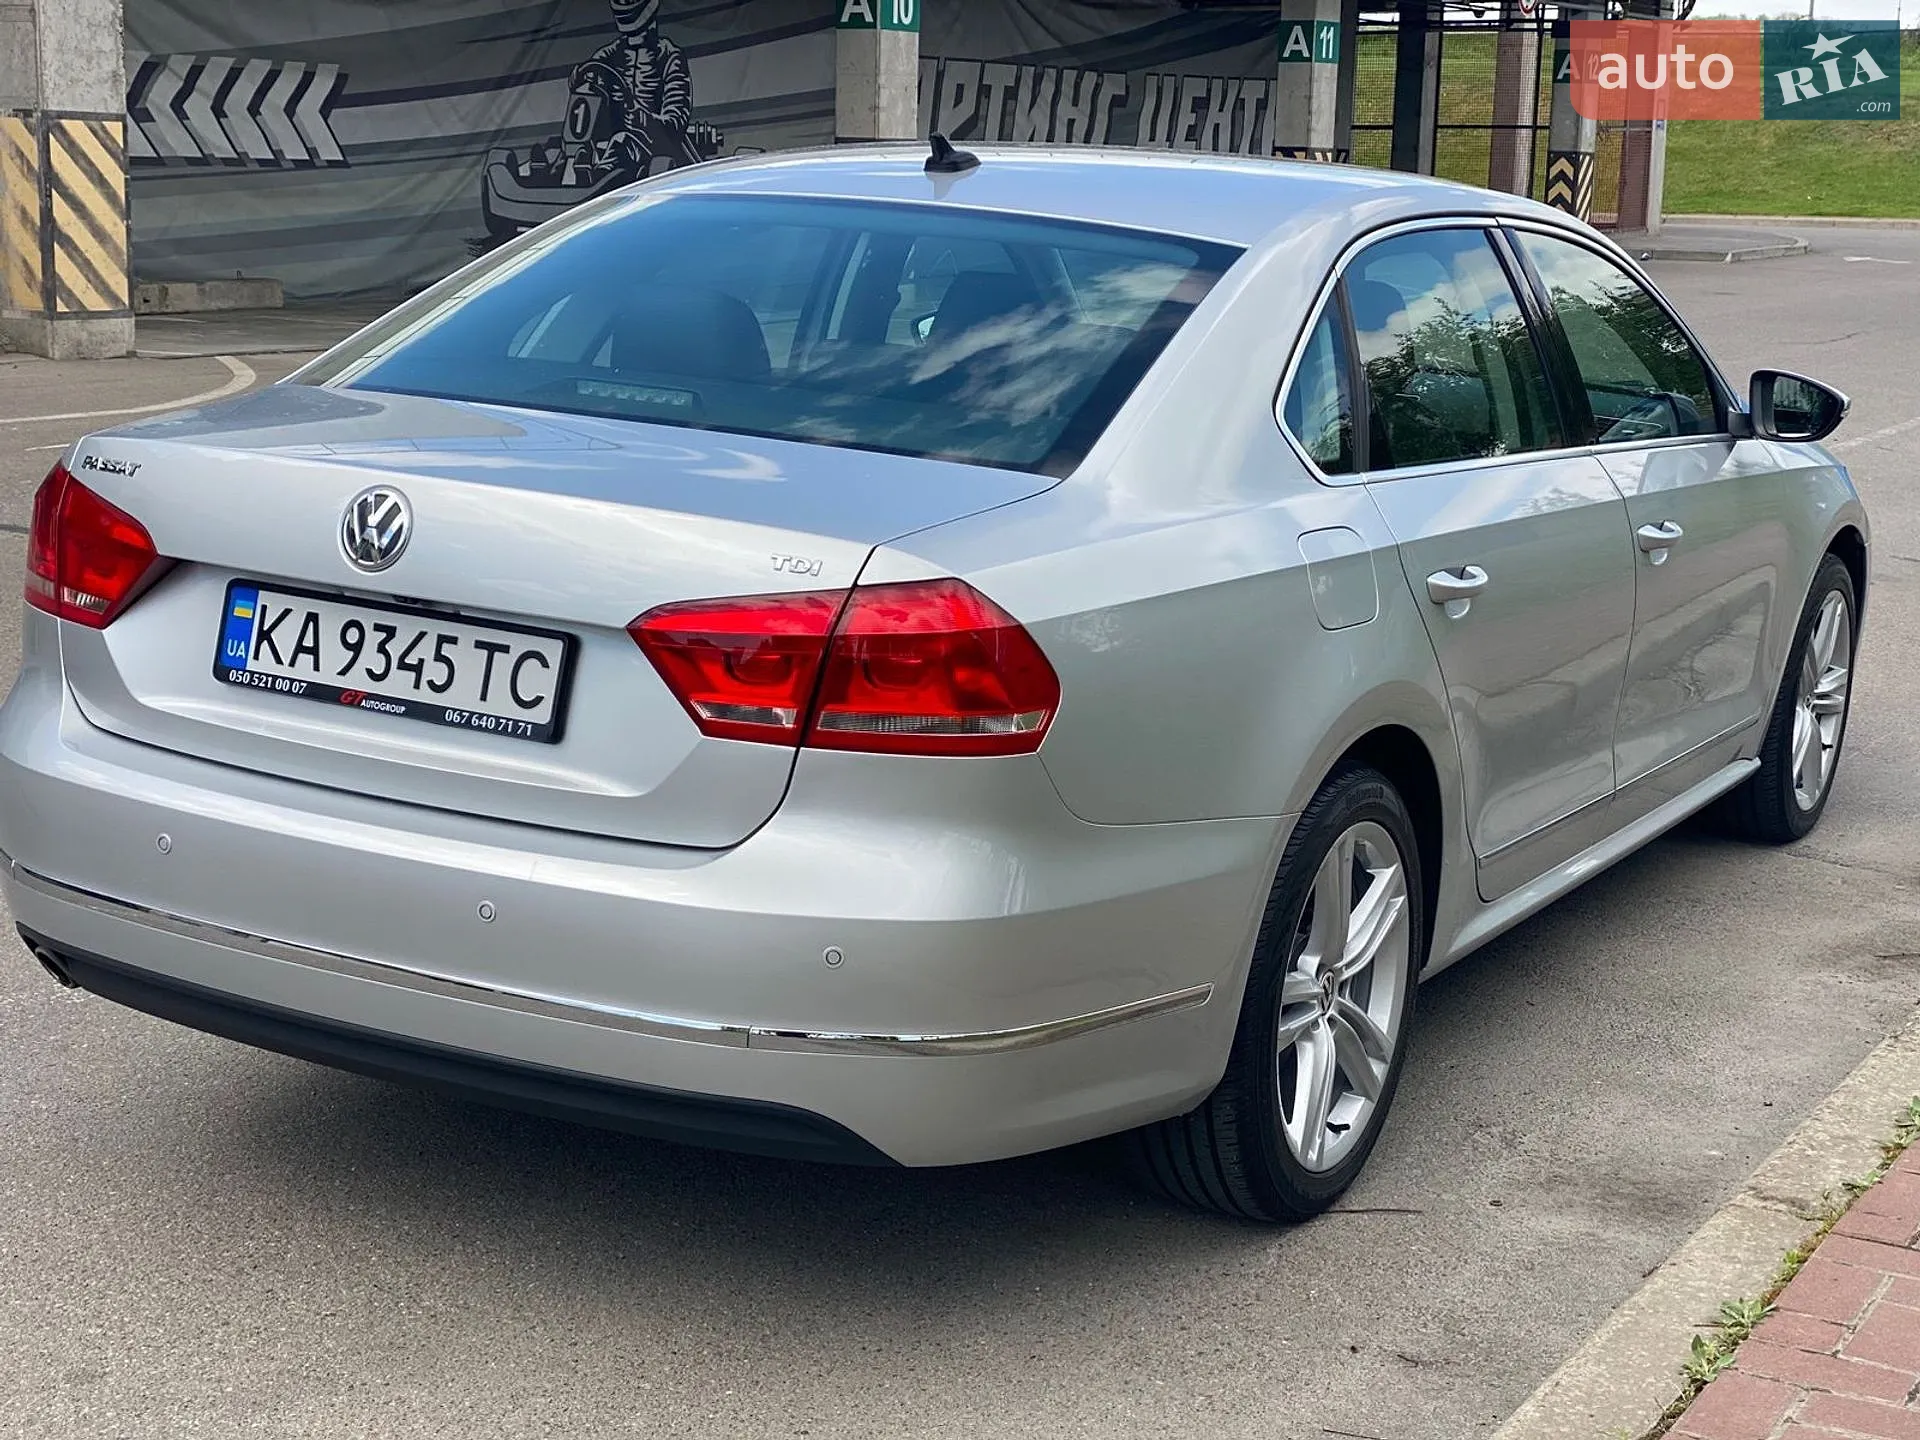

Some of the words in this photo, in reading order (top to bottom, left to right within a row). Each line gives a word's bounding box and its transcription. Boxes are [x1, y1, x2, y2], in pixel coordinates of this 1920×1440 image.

[840, 0, 874, 22] A
[892, 0, 914, 25] 10
[1282, 25, 1310, 58] A
[1320, 26, 1335, 59] 11
[574, 103, 585, 133] 1
[81, 455, 142, 478] PASSAT
[771, 554, 823, 577] TDI
[227, 638, 246, 659] UA
[252, 603, 321, 673] KA
[336, 618, 459, 694] 9345
[473, 639, 550, 710] TC
[229, 669, 250, 685] 050
[251, 673, 273, 688] 521
[275, 679, 290, 692] 00
[292, 681, 308, 694] 07
[360, 699, 406, 714] AUTOGROUP
[445, 709, 470, 724] 067
[471, 714, 495, 729] 640
[497, 719, 513, 733] 71
[516, 722, 533, 736] 71
